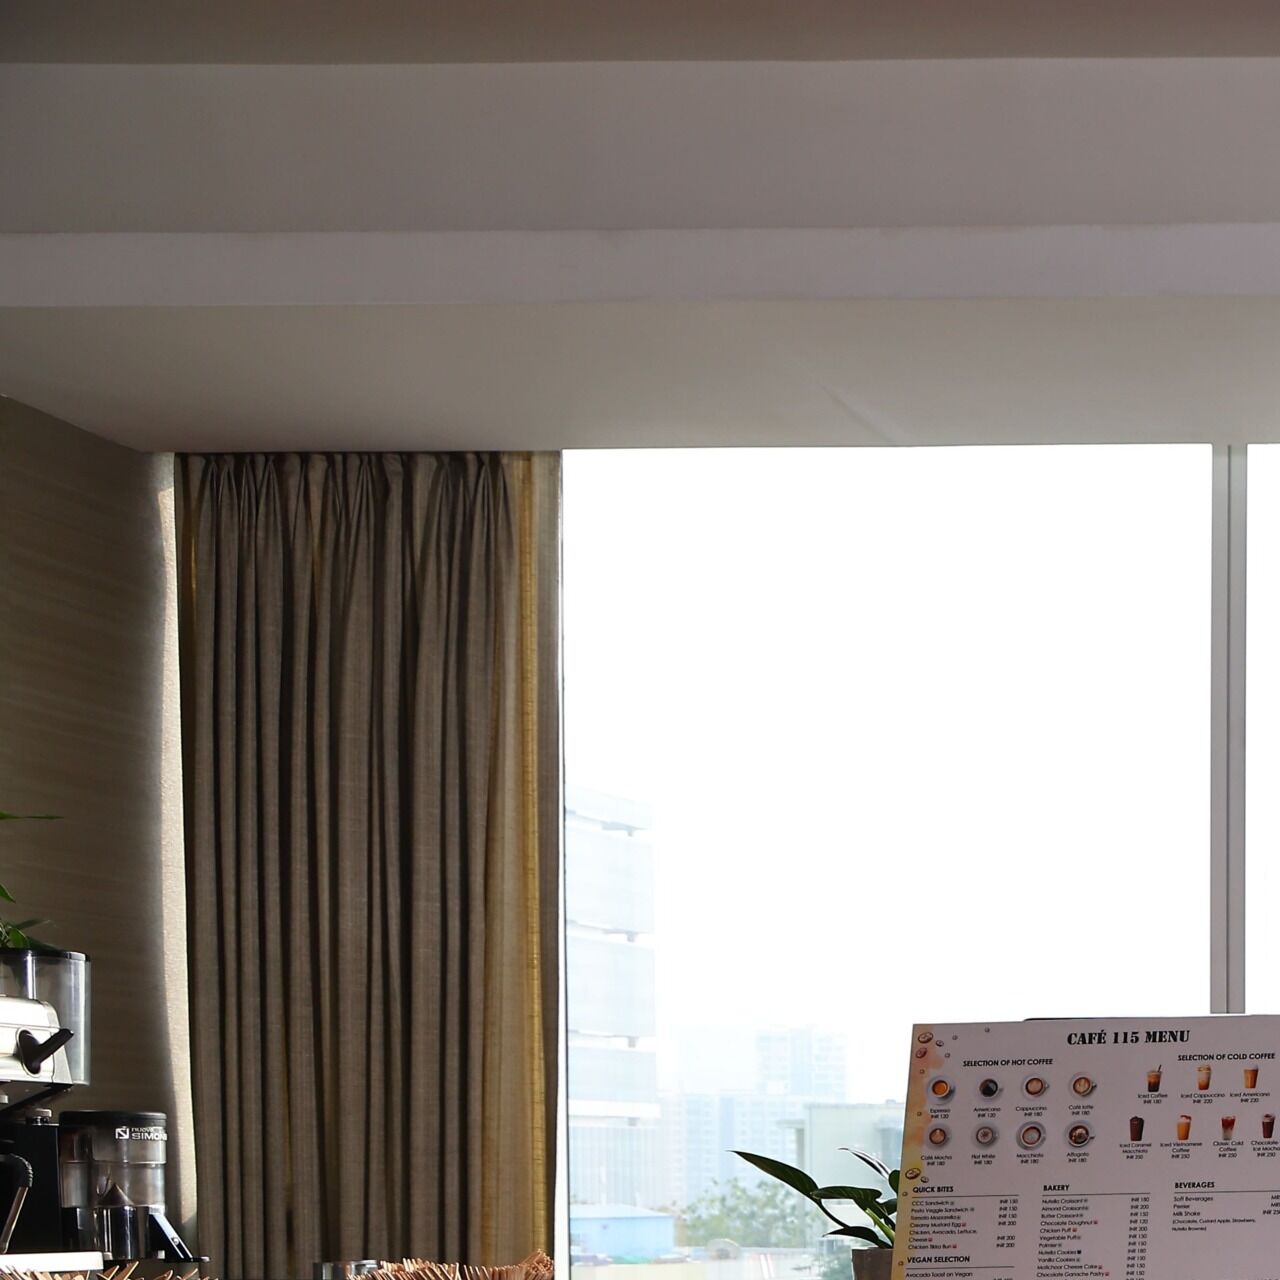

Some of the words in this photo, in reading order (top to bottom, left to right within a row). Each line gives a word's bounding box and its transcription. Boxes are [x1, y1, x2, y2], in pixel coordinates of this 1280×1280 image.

[1067, 1030, 1106, 1045] CAFÉ
[1113, 1031, 1139, 1044] 115
[1145, 1030, 1190, 1043] MENU
[963, 1059, 999, 1067] SELECTION
